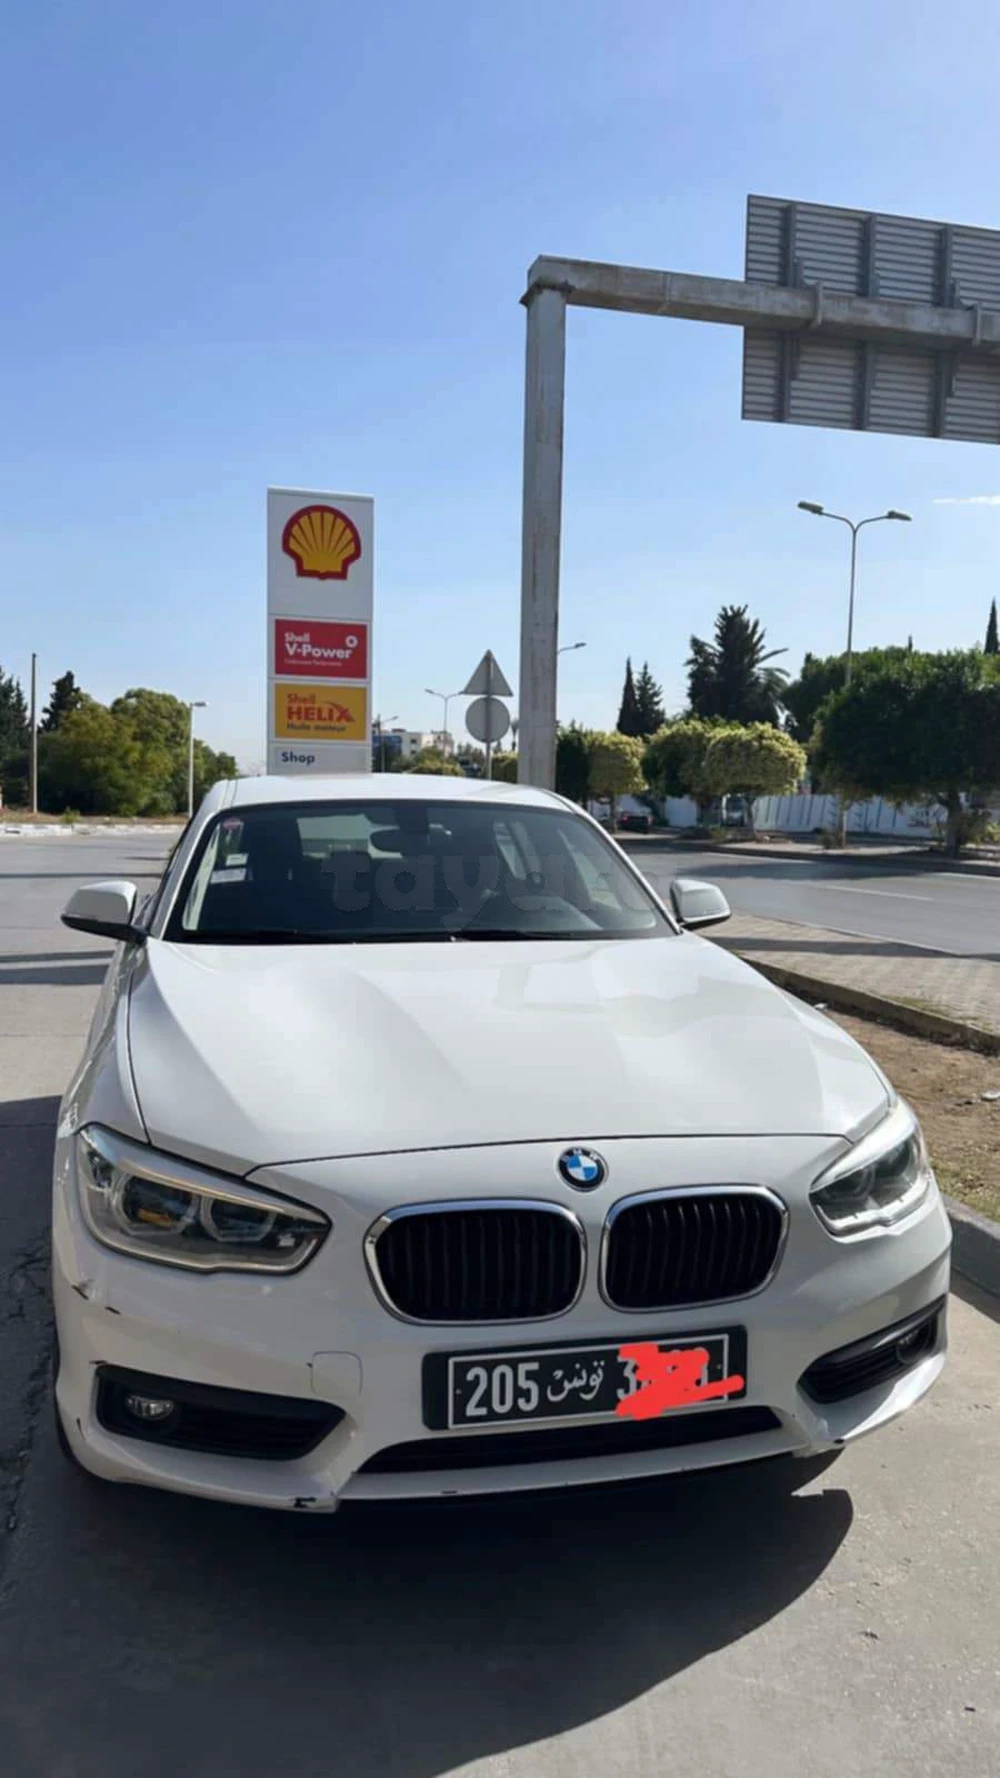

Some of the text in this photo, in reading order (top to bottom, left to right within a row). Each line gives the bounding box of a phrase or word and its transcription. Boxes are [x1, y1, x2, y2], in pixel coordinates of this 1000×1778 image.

[284, 632, 311, 643] Shell
[284, 643, 353, 659] V-Power
[286, 692, 316, 704] Shell
[281, 750, 316, 766] Shop
[466, 1362, 540, 1417] 205
[546, 1360, 606, 1402] تونس
